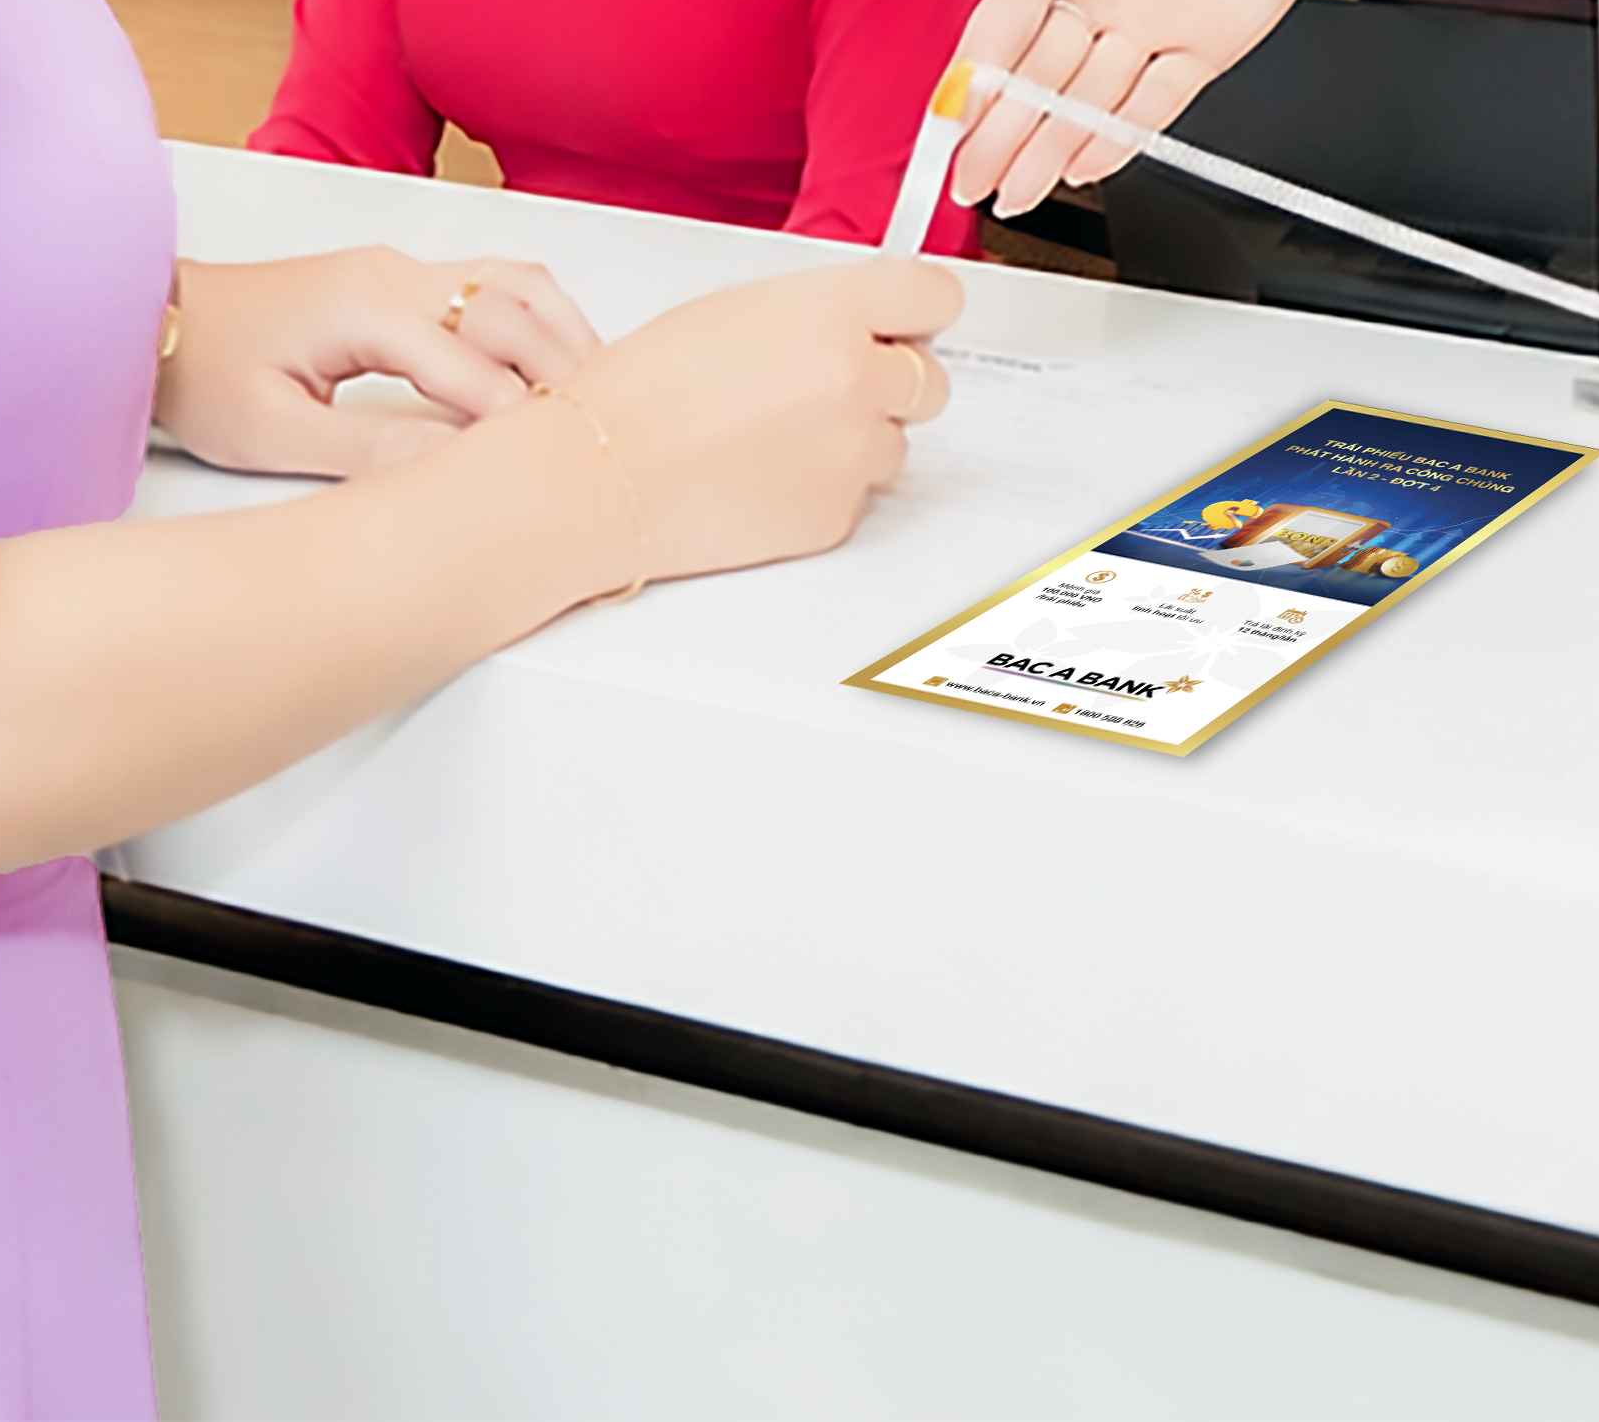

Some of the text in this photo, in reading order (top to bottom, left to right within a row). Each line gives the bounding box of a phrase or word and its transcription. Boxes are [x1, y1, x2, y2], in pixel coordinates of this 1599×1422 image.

[1285, 445, 1516, 494] PHÁT HÀNH RA CÔNG CHÚNG
[1324, 440, 1363, 453] TRÁI
[1411, 456, 1450, 469] BAC
[1449, 463, 1463, 472] A
[1463, 466, 1513, 481] BANK
[1366, 472, 1381, 481] 2
[1429, 484, 1443, 493] 4
[1272, 528, 1340, 547] BOND
[986, 653, 1166, 698] BAC A BANK
